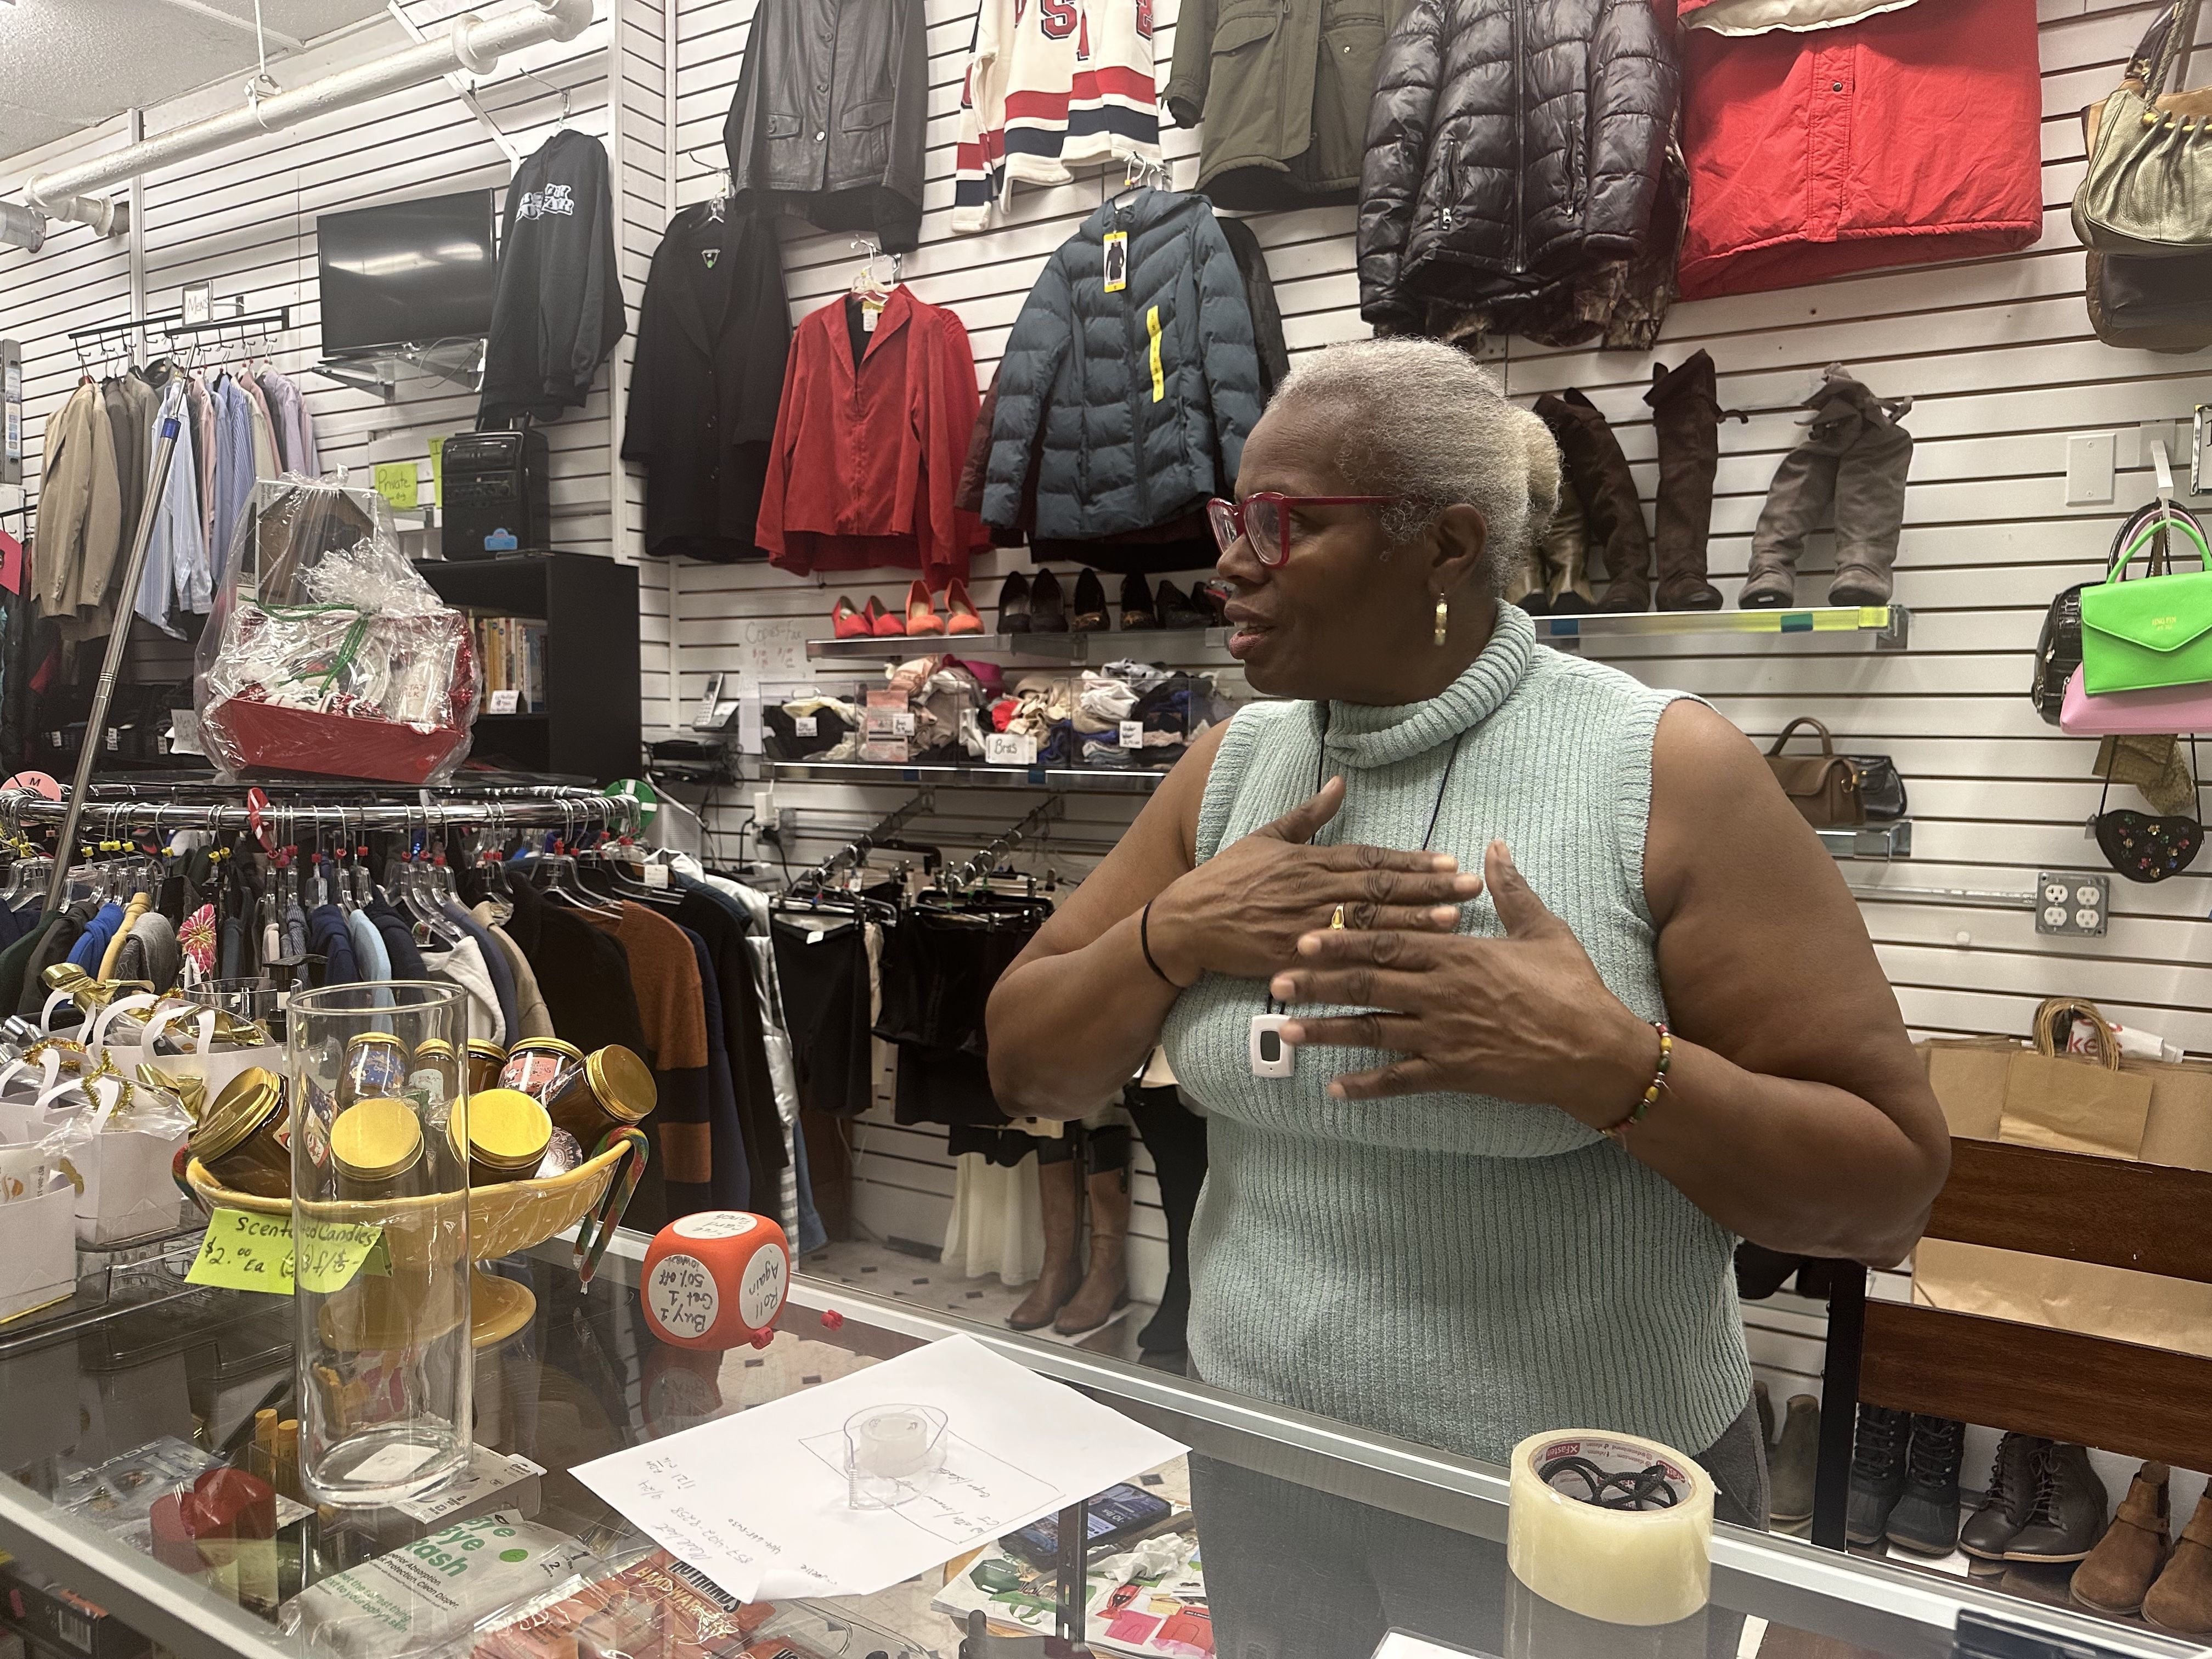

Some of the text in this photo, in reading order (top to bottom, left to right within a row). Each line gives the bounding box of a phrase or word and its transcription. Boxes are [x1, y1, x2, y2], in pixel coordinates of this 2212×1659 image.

[379, 468, 411, 493] Private
[995, 738, 1018, 755] Bras
[30, 777, 41, 787] M
[692, 1227, 727, 1236] Free
[703, 1222, 744, 1231] Card
[659, 1269, 677, 1286] off
[749, 1260, 778, 1295] Again
[686, 1291, 713, 1310] Get
[755, 1286, 778, 1319] Roll
[673, 1304, 706, 1333] Buy
[1547, 1444, 1579, 1457] XFasten
[462, 1516, 517, 1537] Bye
[434, 1526, 485, 1551] Bye
[399, 1538, 468, 1577] Rash
[571, 1550, 590, 1561] 1
[549, 1561, 561, 1570] 2
[417, 1581, 437, 1596] Clean
